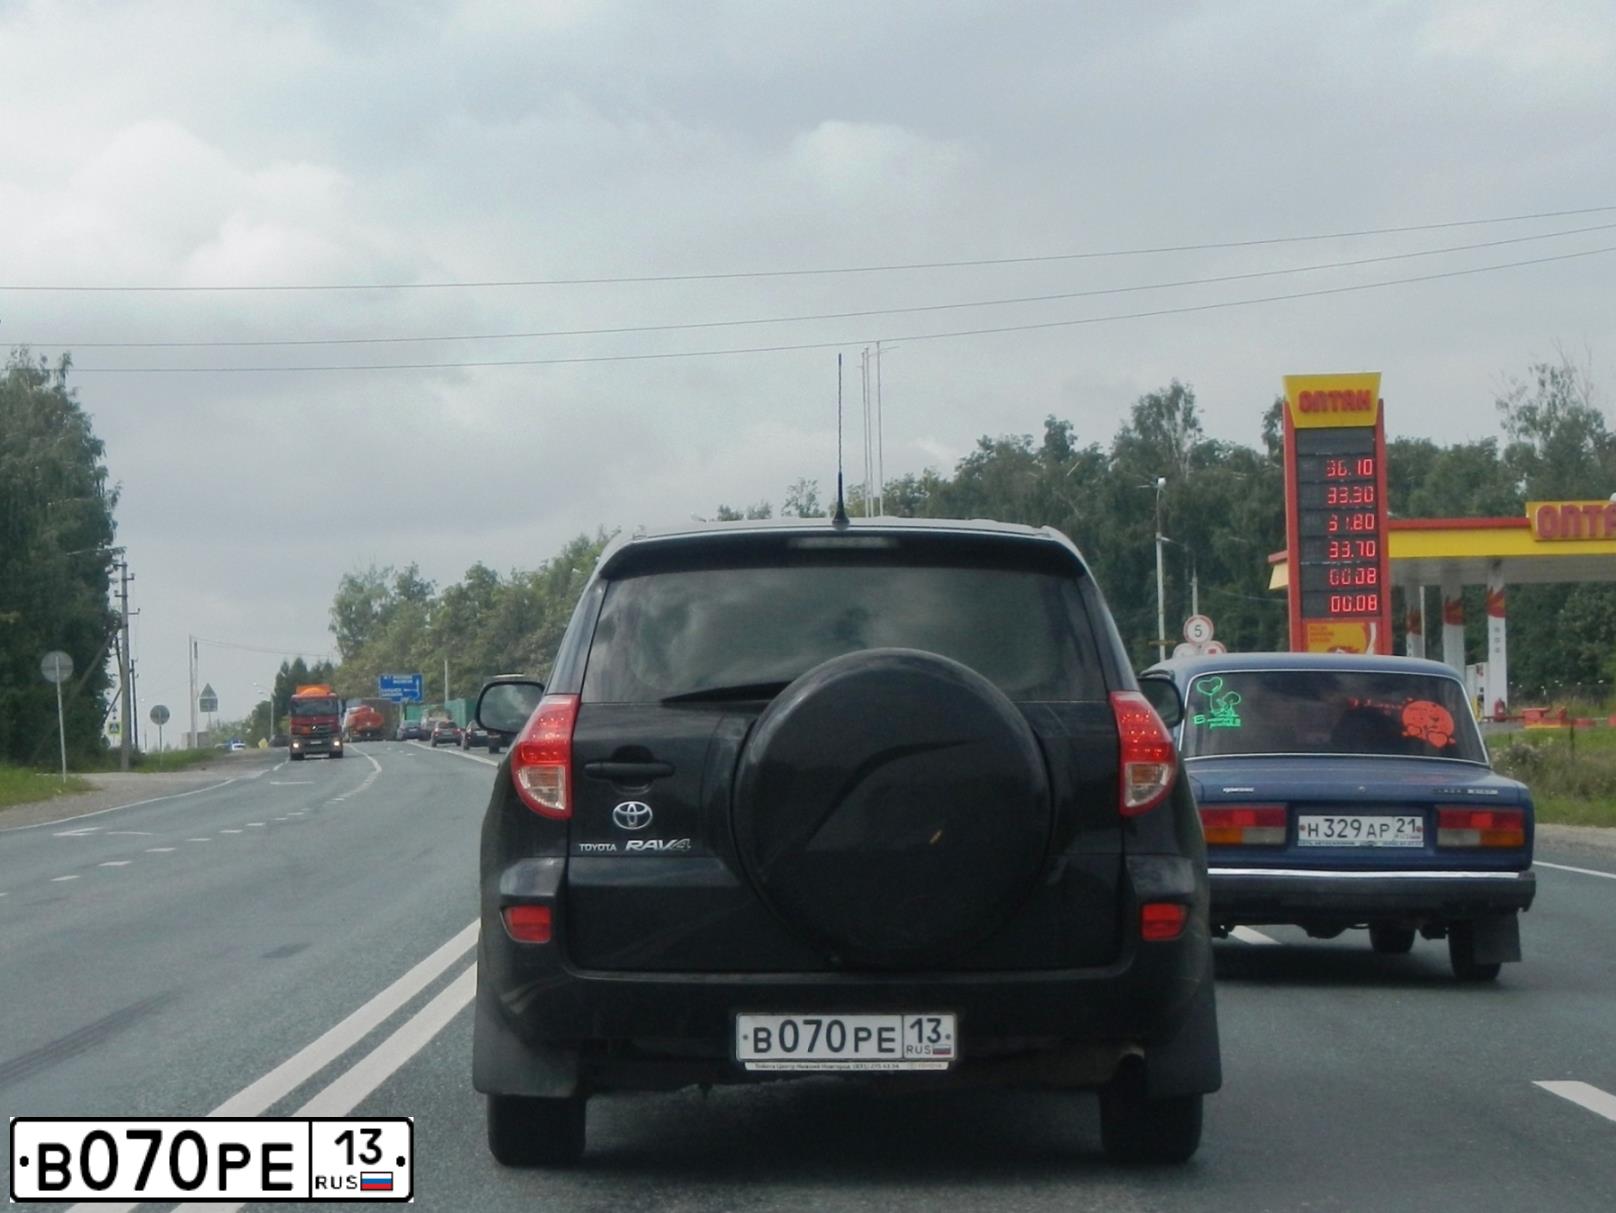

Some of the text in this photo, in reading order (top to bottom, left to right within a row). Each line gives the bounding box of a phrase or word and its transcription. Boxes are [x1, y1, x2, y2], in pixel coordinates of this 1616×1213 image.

[1299, 390, 1372, 413] ОПТАН
[1327, 486, 1374, 504] 33.30
[1328, 540, 1376, 558] 33.70
[1194, 624, 1203, 638] 5
[578, 838, 691, 852] TOYOTA RAV4
[909, 1018, 942, 1044] 13
[906, 1045, 931, 1056] RUS
